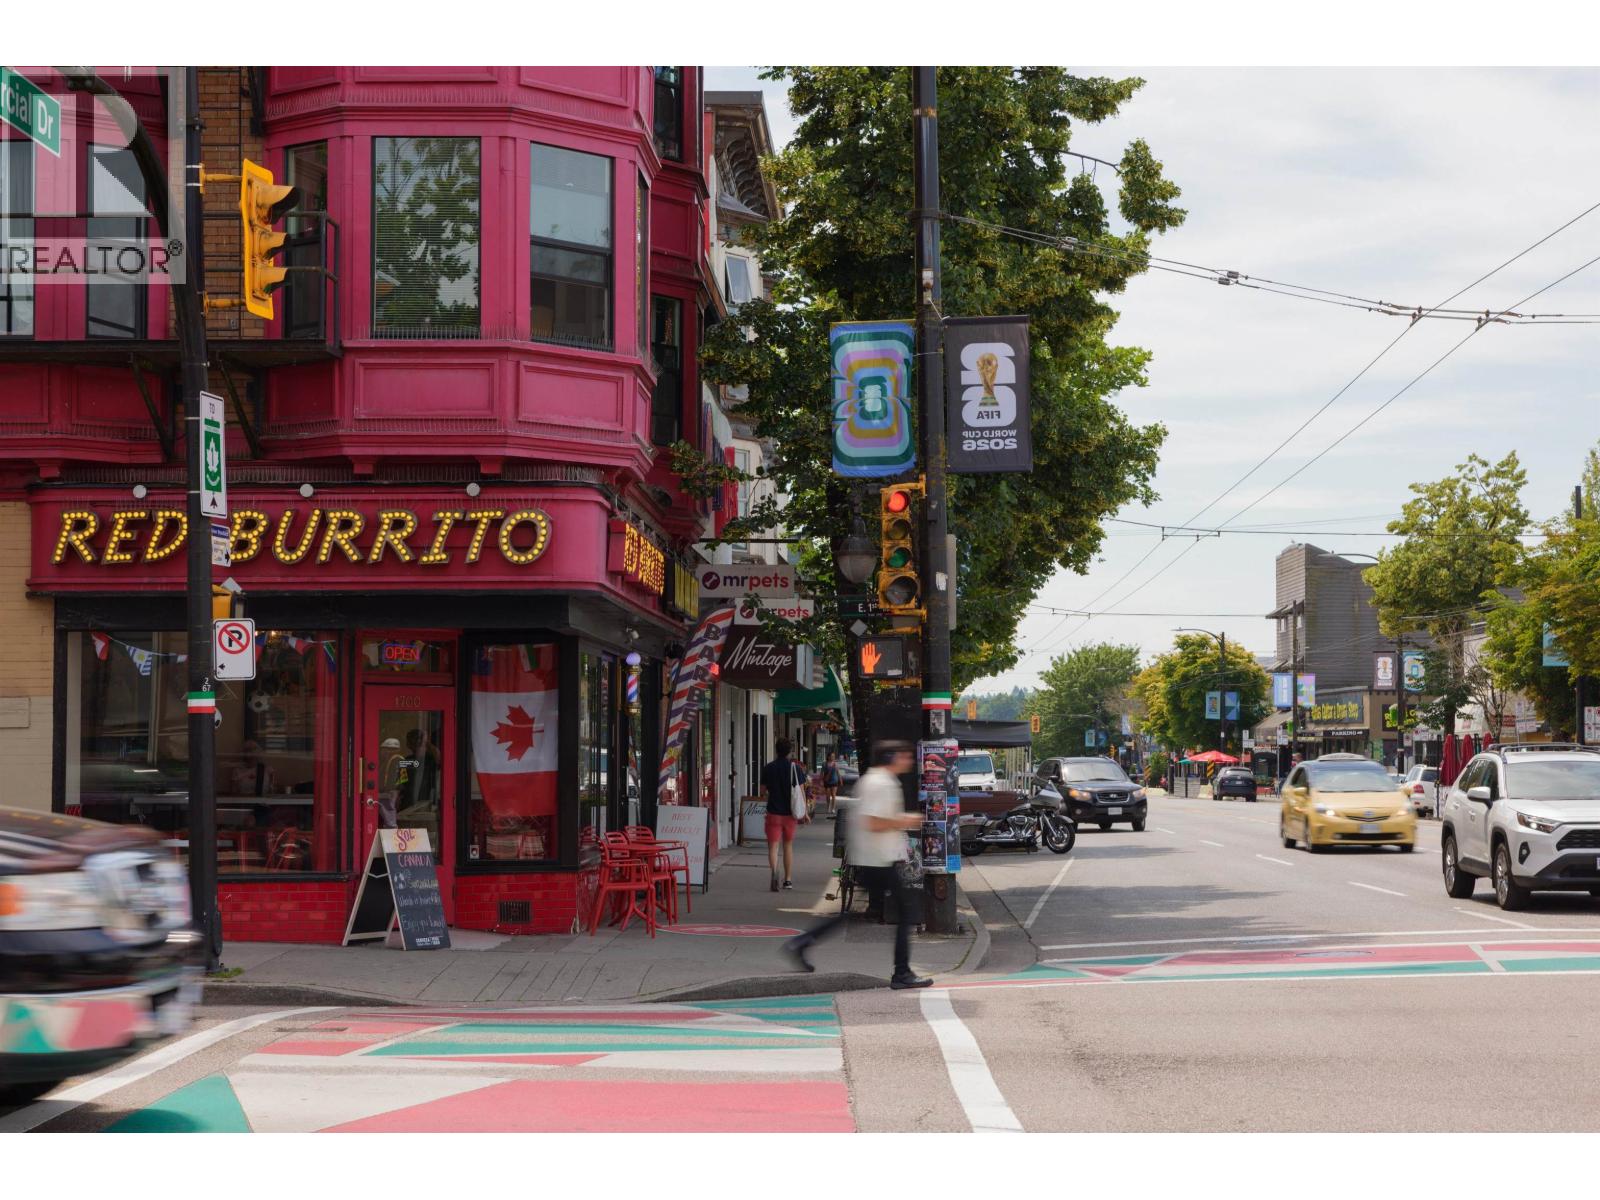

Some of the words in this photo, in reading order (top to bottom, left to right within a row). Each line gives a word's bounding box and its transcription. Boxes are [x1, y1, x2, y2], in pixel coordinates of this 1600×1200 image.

[38, 98, 54, 140] Dr
[50, 508, 188, 564] RED
[228, 508, 553, 565] BURRITO
[385, 646, 419, 660] OPEN
[723, 635, 793, 677] Mintage
